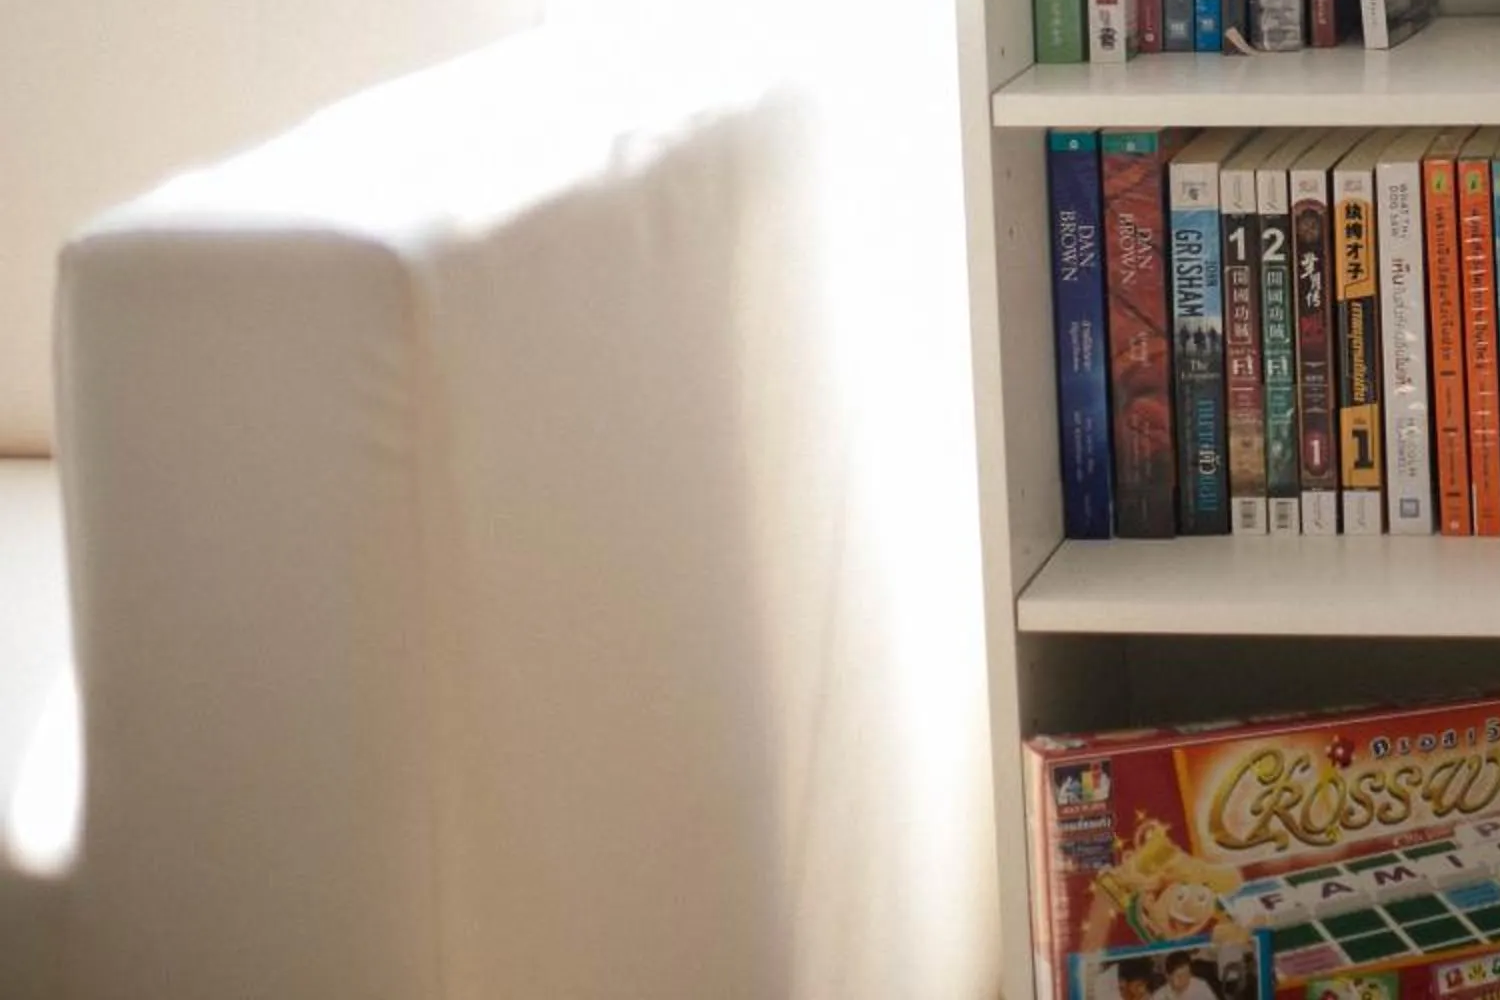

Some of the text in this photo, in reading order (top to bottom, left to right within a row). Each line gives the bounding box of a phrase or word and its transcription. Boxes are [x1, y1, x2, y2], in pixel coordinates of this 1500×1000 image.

[1059, 211, 1078, 282] BROWN
[1077, 225, 1095, 268] DAN
[1119, 213, 1137, 285] BROWN
[1136, 227, 1153, 270] DAN
[1228, 227, 1248, 261] 1
[1263, 228, 1286, 261] 2
[1175, 229, 1204, 318] GRISHAM
[1308, 438, 1321, 466] 1
[1351, 428, 1374, 470] 1
